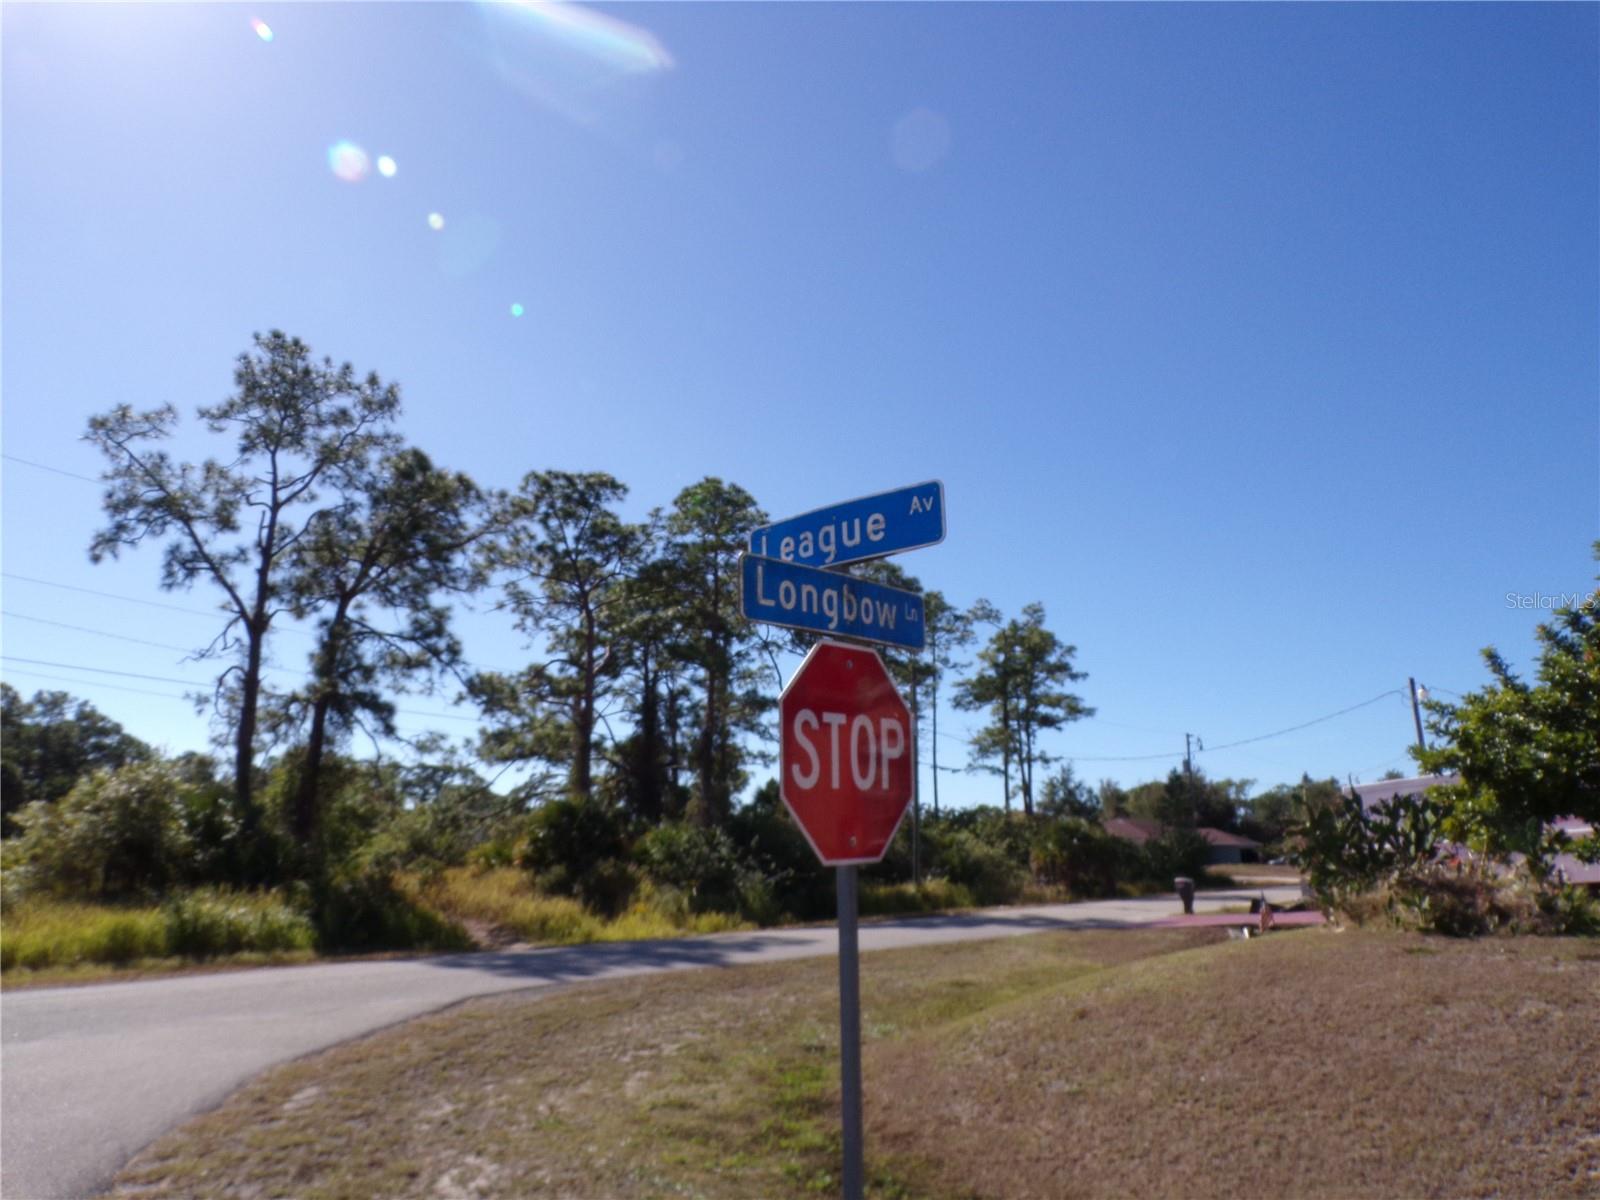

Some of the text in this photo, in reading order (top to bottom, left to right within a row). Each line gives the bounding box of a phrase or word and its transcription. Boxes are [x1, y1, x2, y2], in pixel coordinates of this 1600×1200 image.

[909, 496, 933, 515] Av
[756, 565, 918, 630] Longbow Ln
[791, 708, 905, 791] STOP
